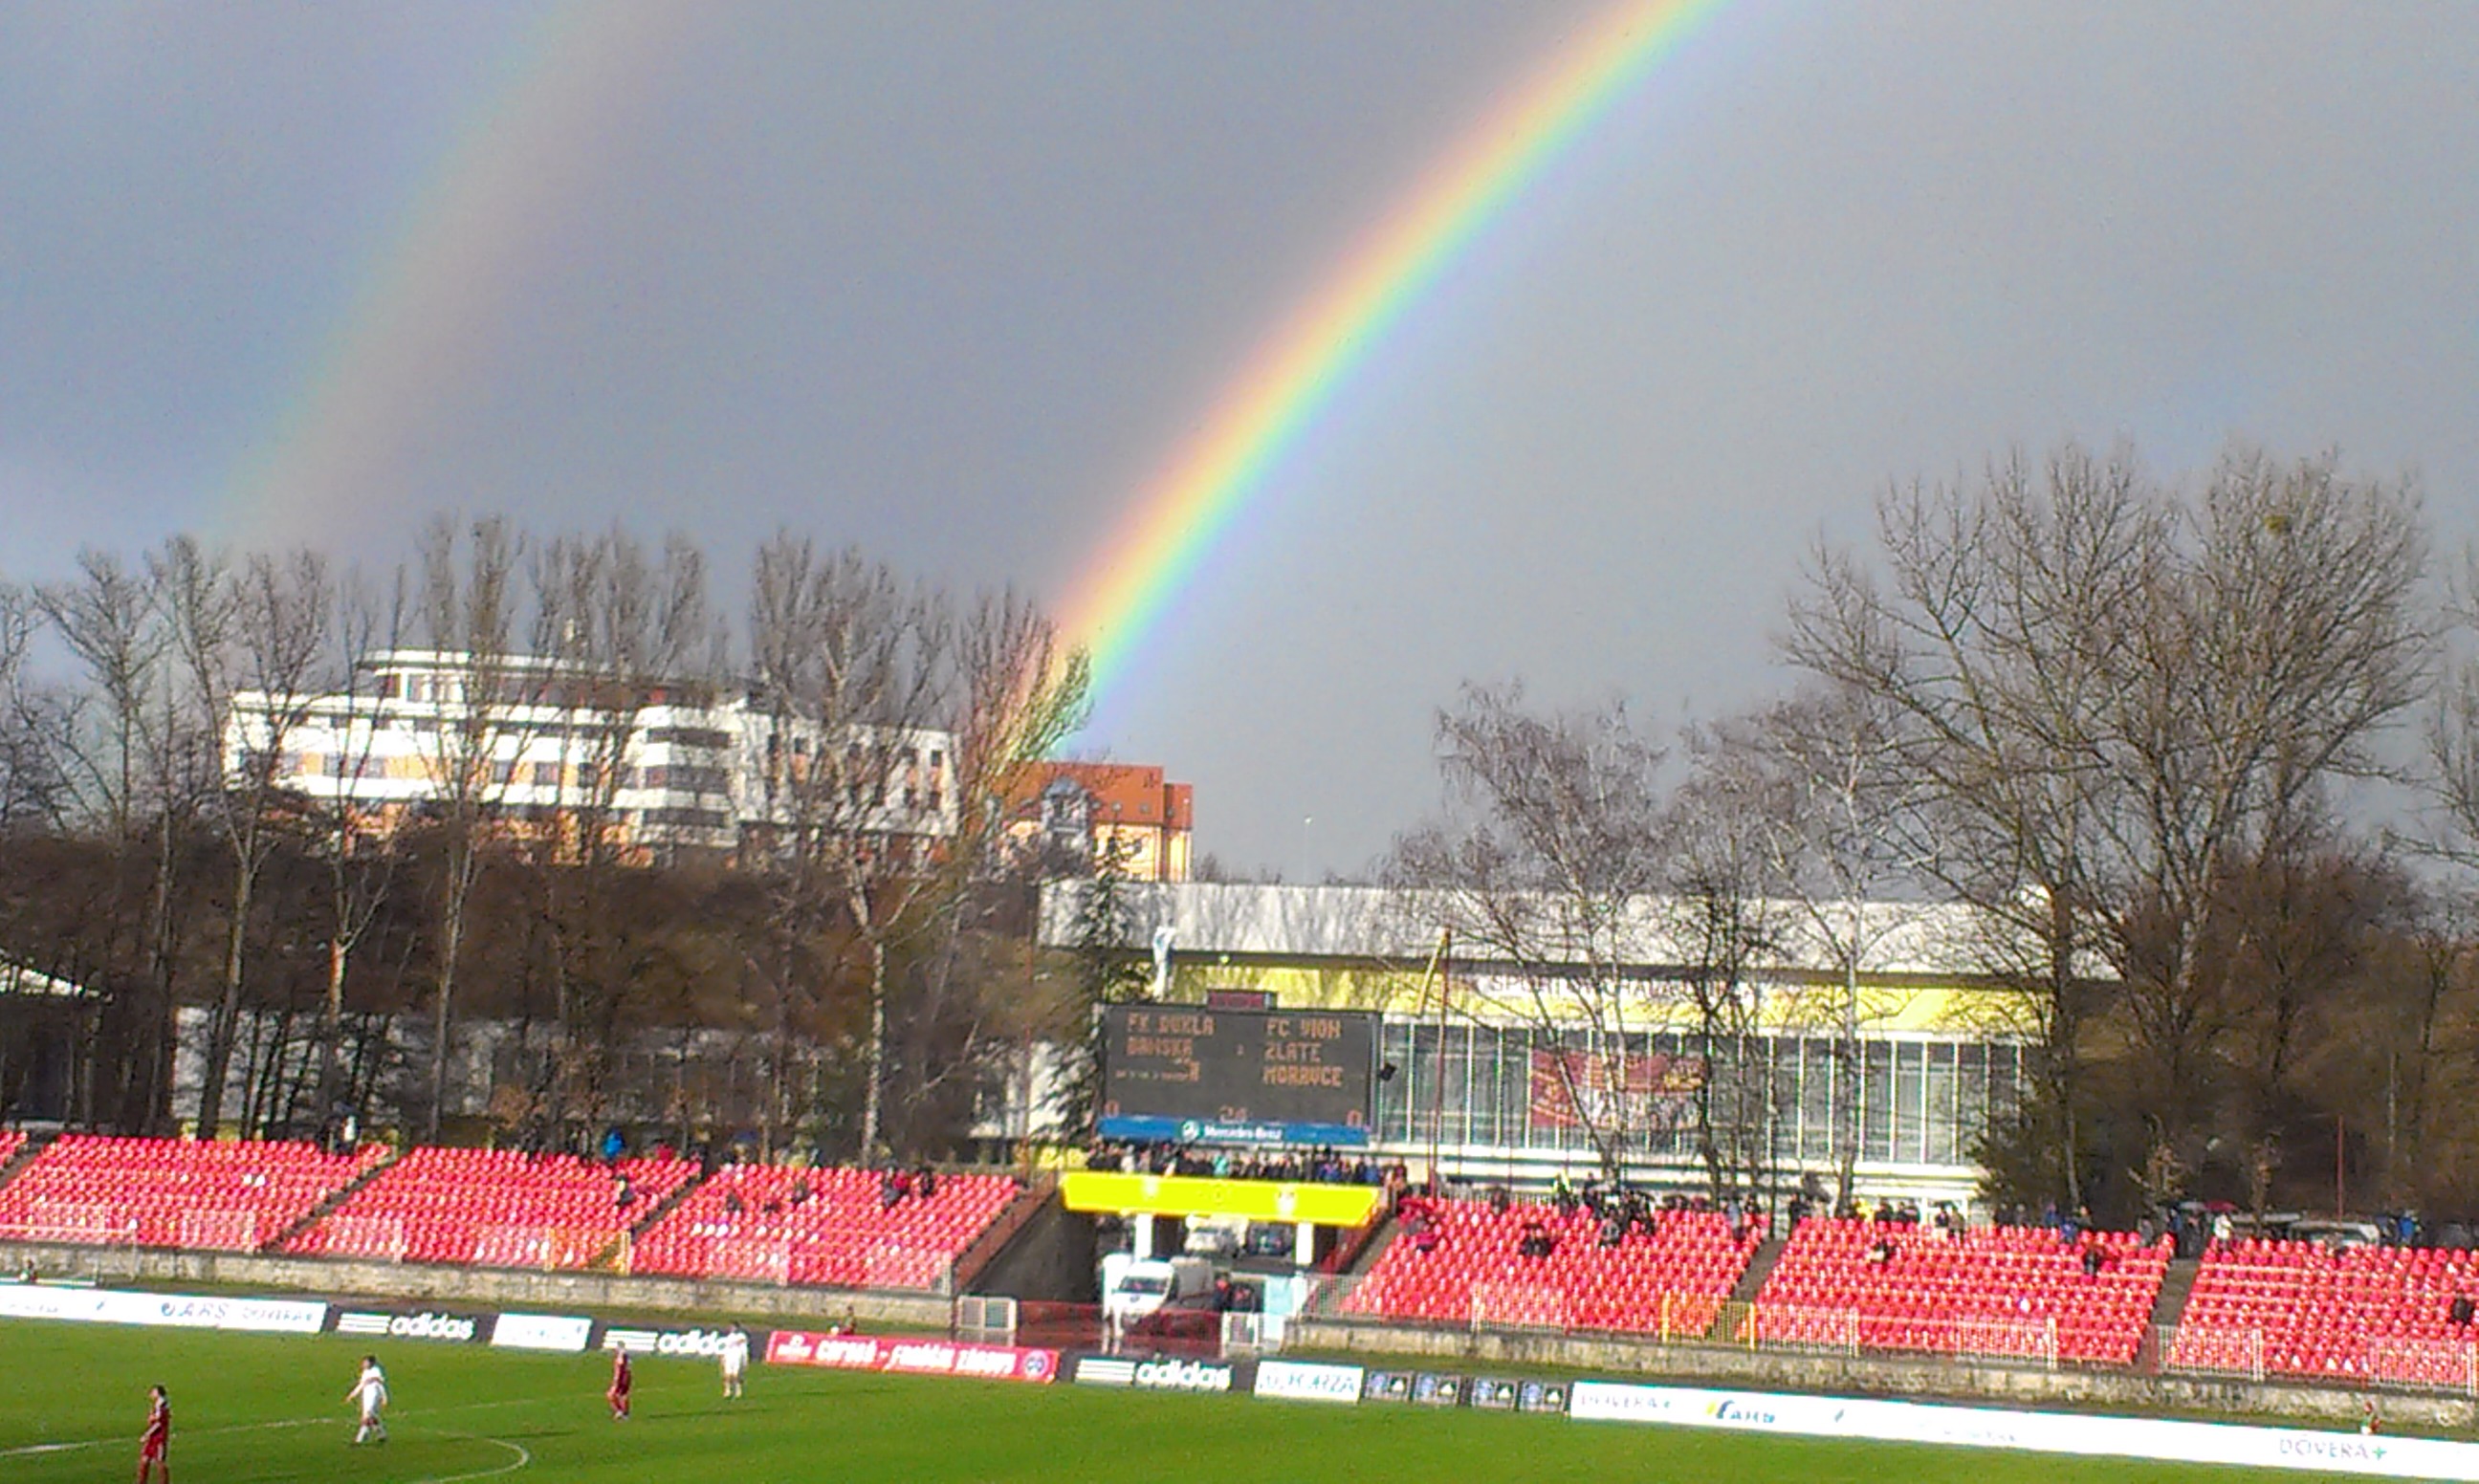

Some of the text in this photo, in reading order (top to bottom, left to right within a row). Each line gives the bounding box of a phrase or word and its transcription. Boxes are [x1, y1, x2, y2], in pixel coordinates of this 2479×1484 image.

[1265, 1017, 1289, 1037] FC
[390, 1311, 476, 1340] adidas
[1136, 1359, 1232, 1392] adidas
